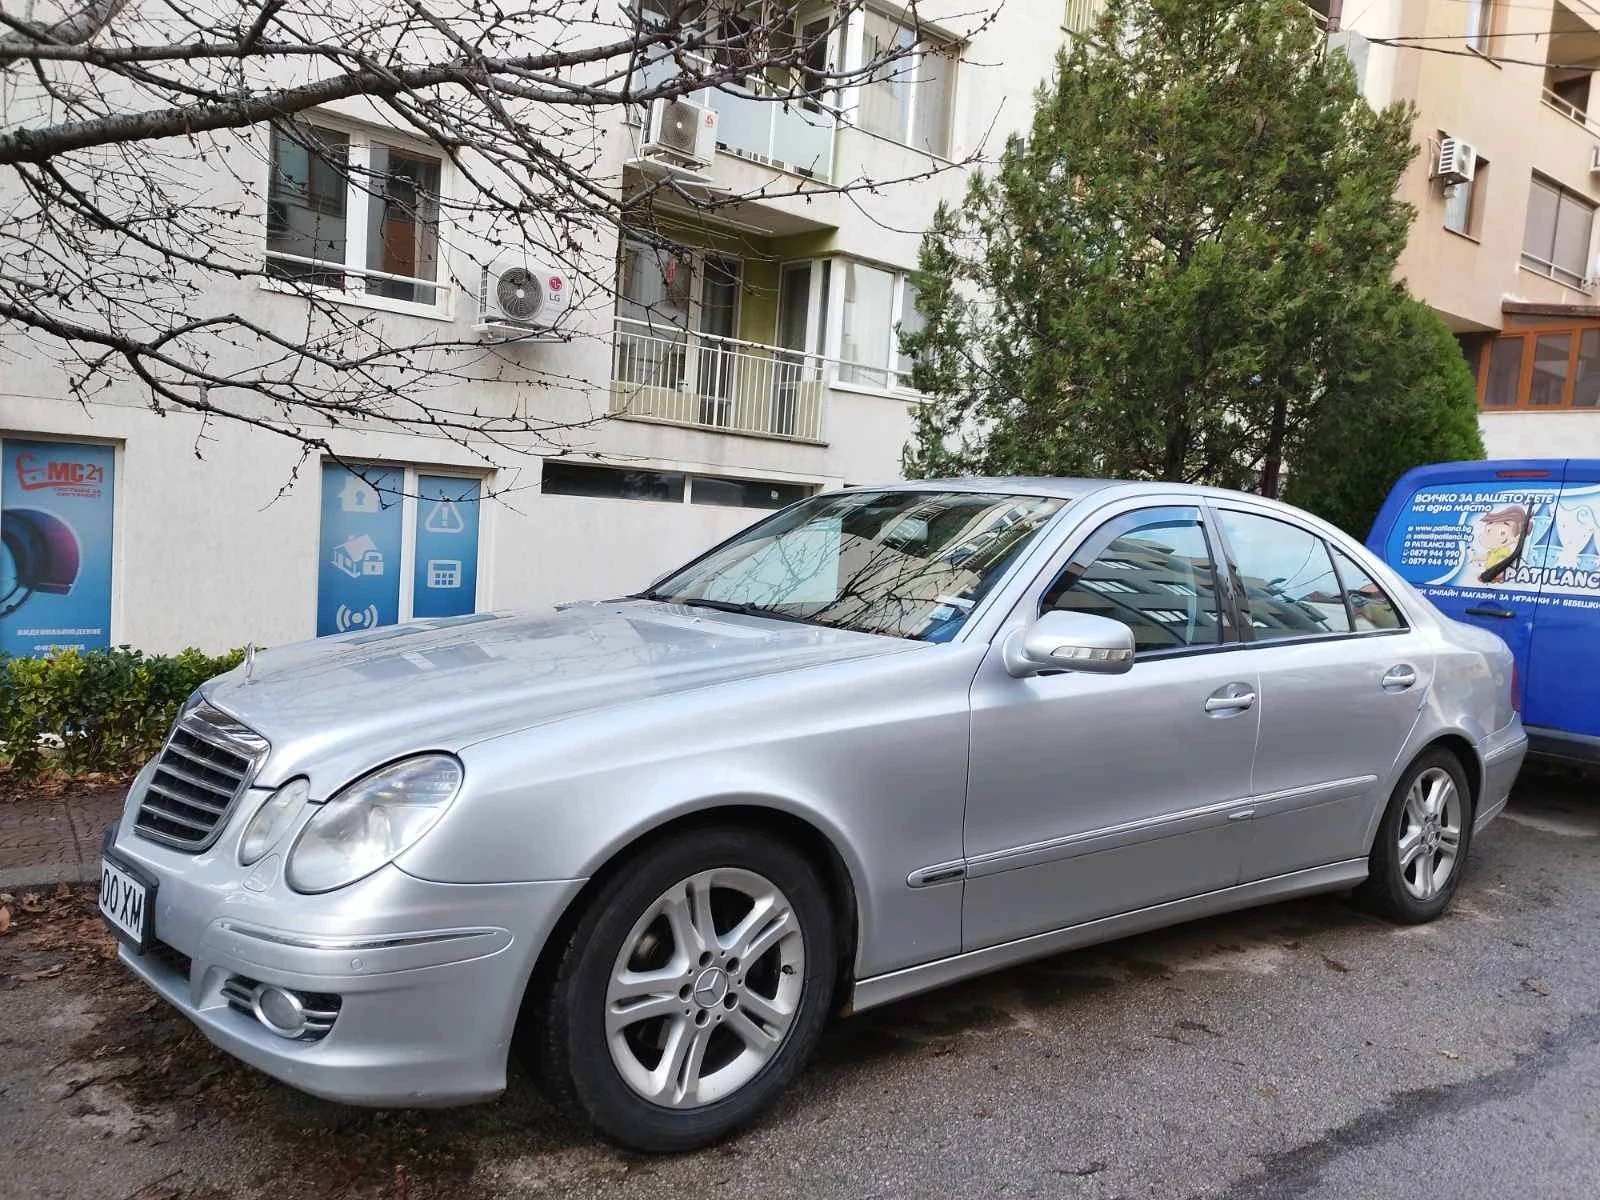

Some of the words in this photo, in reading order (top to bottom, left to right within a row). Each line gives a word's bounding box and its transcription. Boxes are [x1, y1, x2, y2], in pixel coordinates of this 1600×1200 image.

[1415, 493, 1457, 503] ВСИЧКО
[1459, 493, 1473, 503] ЗА
[1475, 494, 1523, 504] ВАШЕТО
[1524, 494, 1554, 505] ДЕТЕ
[1427, 504, 1452, 514] едно
[1453, 504, 1492, 513] място
[1415, 525, 1473, 533] www.patilanci.bg
[1410, 549, 1428, 557] 0879
[1445, 550, 1460, 558] 990
[1408, 557, 1426, 565] 0879
[1427, 558, 1442, 566] 944
[1428, 589, 1459, 597] ОНЛАЙН
[1461, 591, 1496, 599] МАГАЗИН
[1511, 595, 1550, 605] ИГРАЧКИ
[1552, 598, 1560, 606] И
